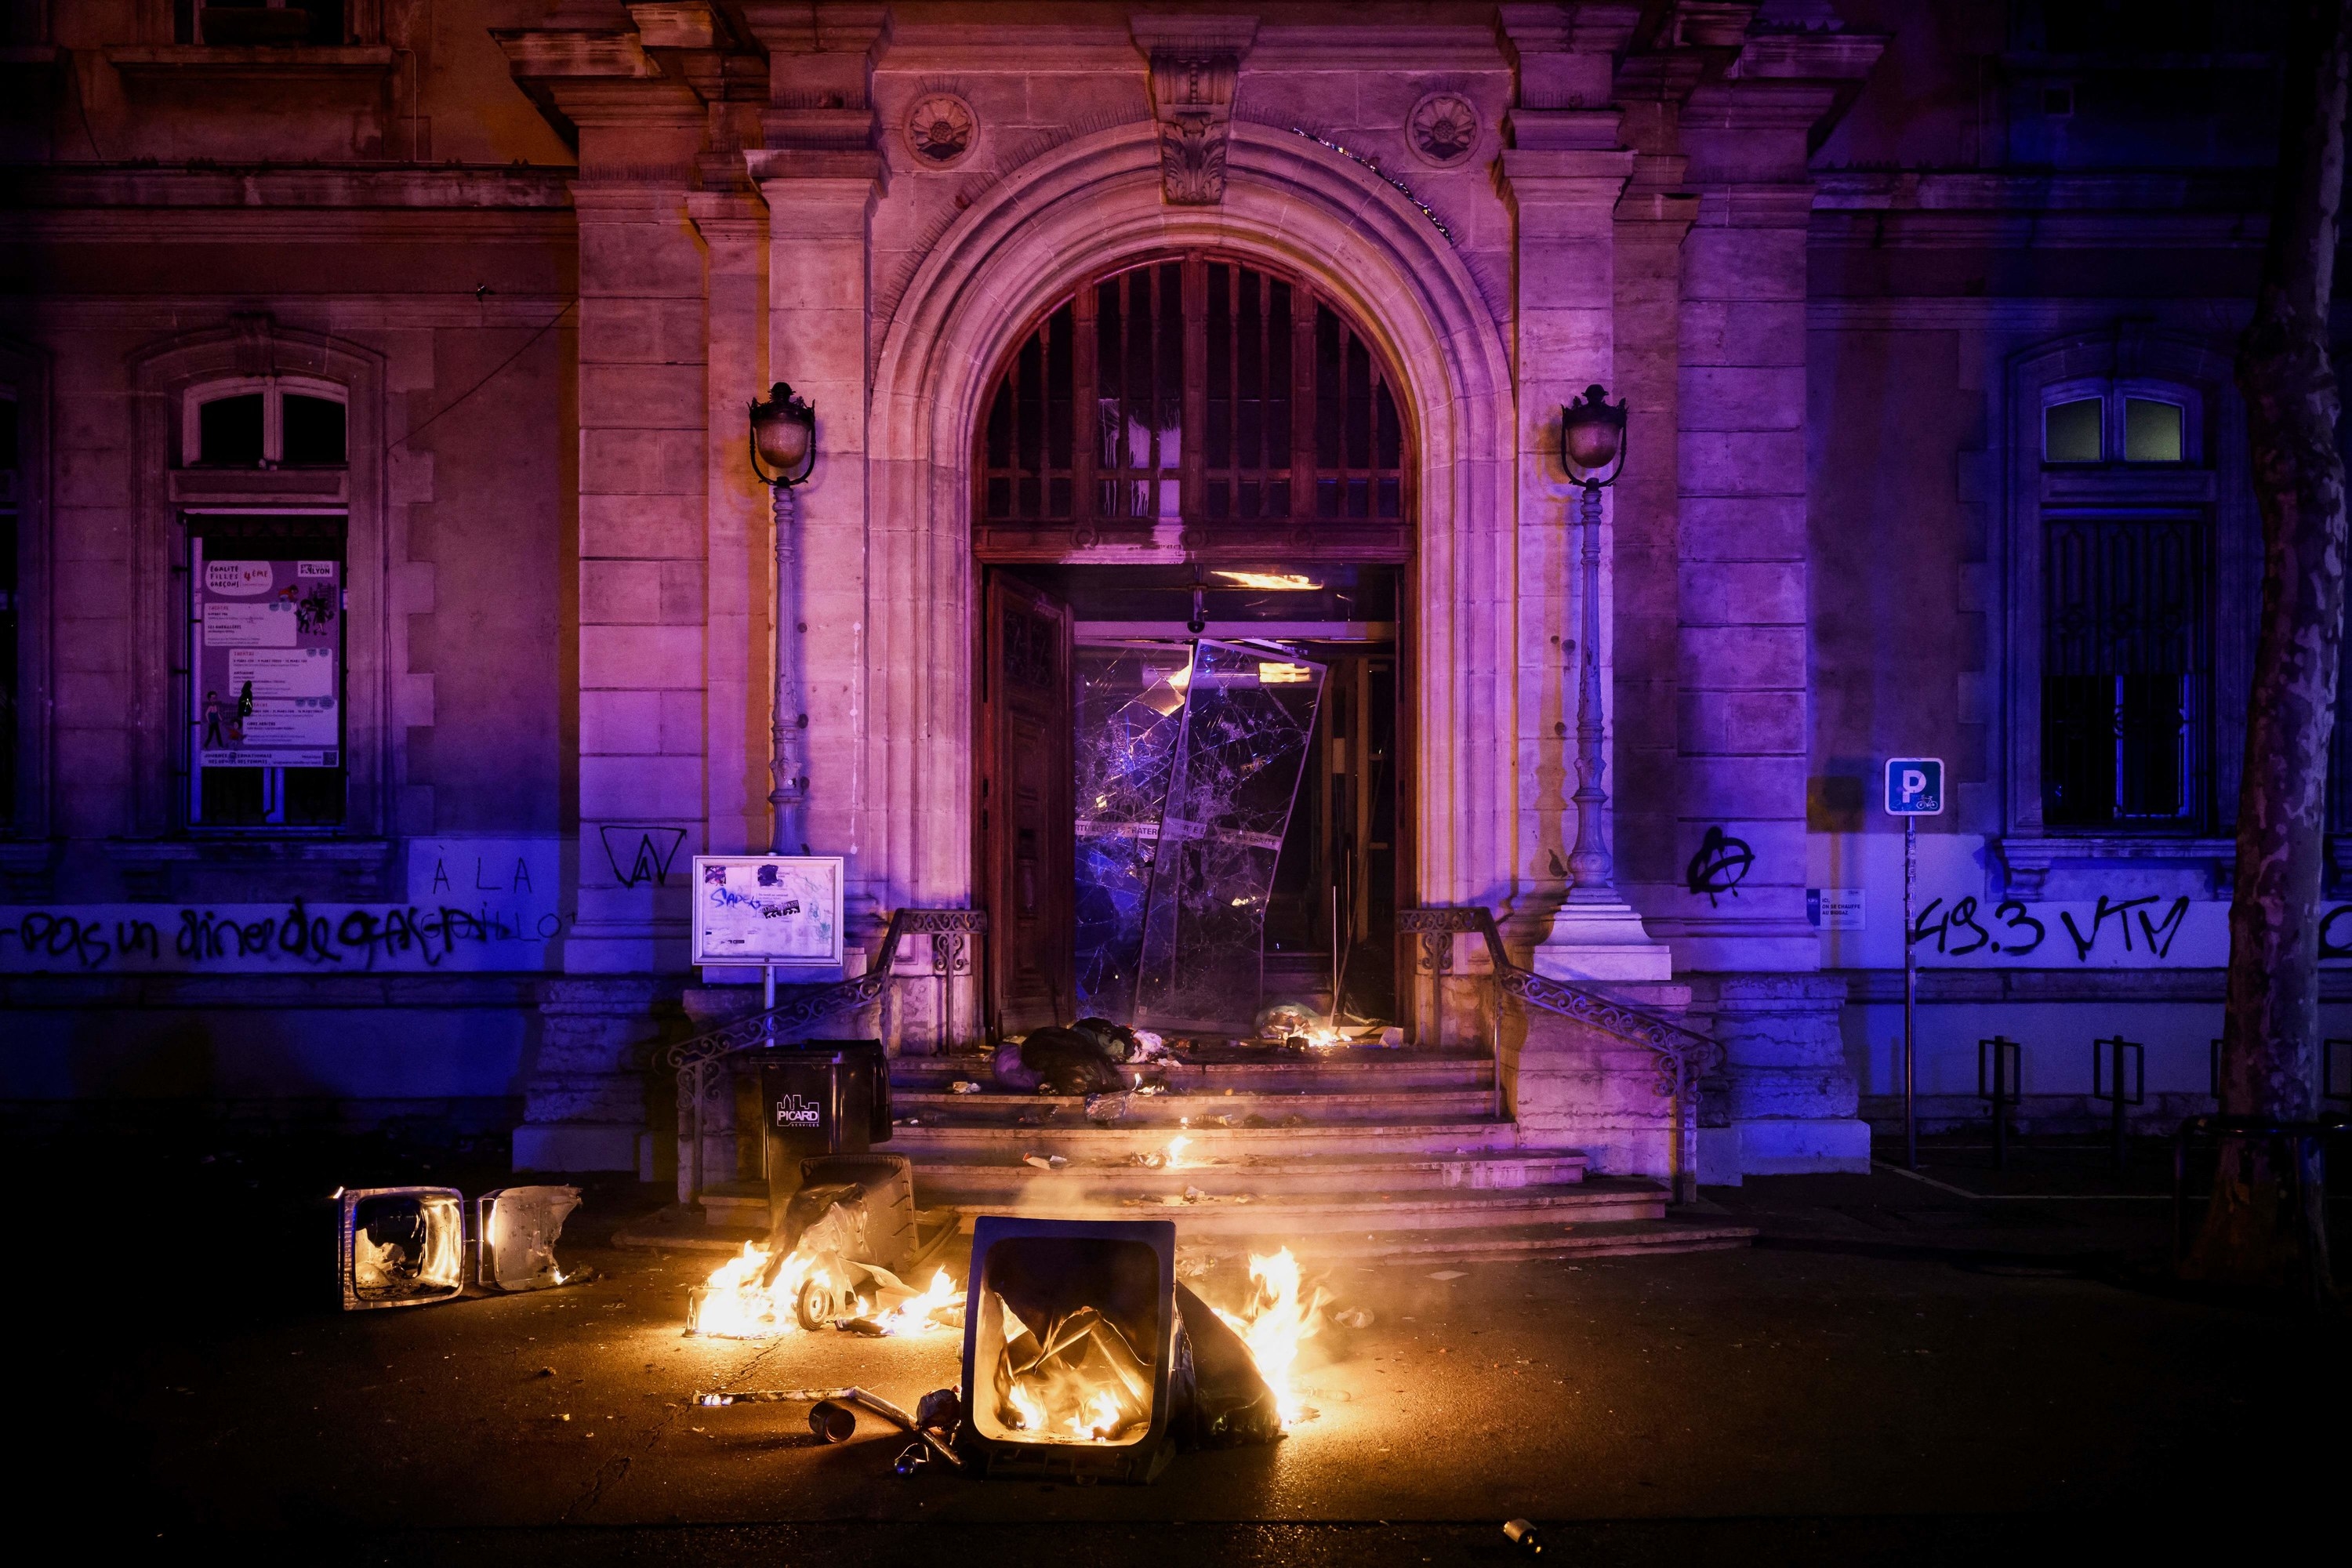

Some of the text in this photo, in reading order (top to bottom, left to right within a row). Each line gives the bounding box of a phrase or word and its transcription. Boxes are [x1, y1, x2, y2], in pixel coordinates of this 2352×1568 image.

[1902, 769, 1926, 804] P
[1915, 895, 2045, 956] 49.3
[779, 1110, 818, 1121] PICARD
